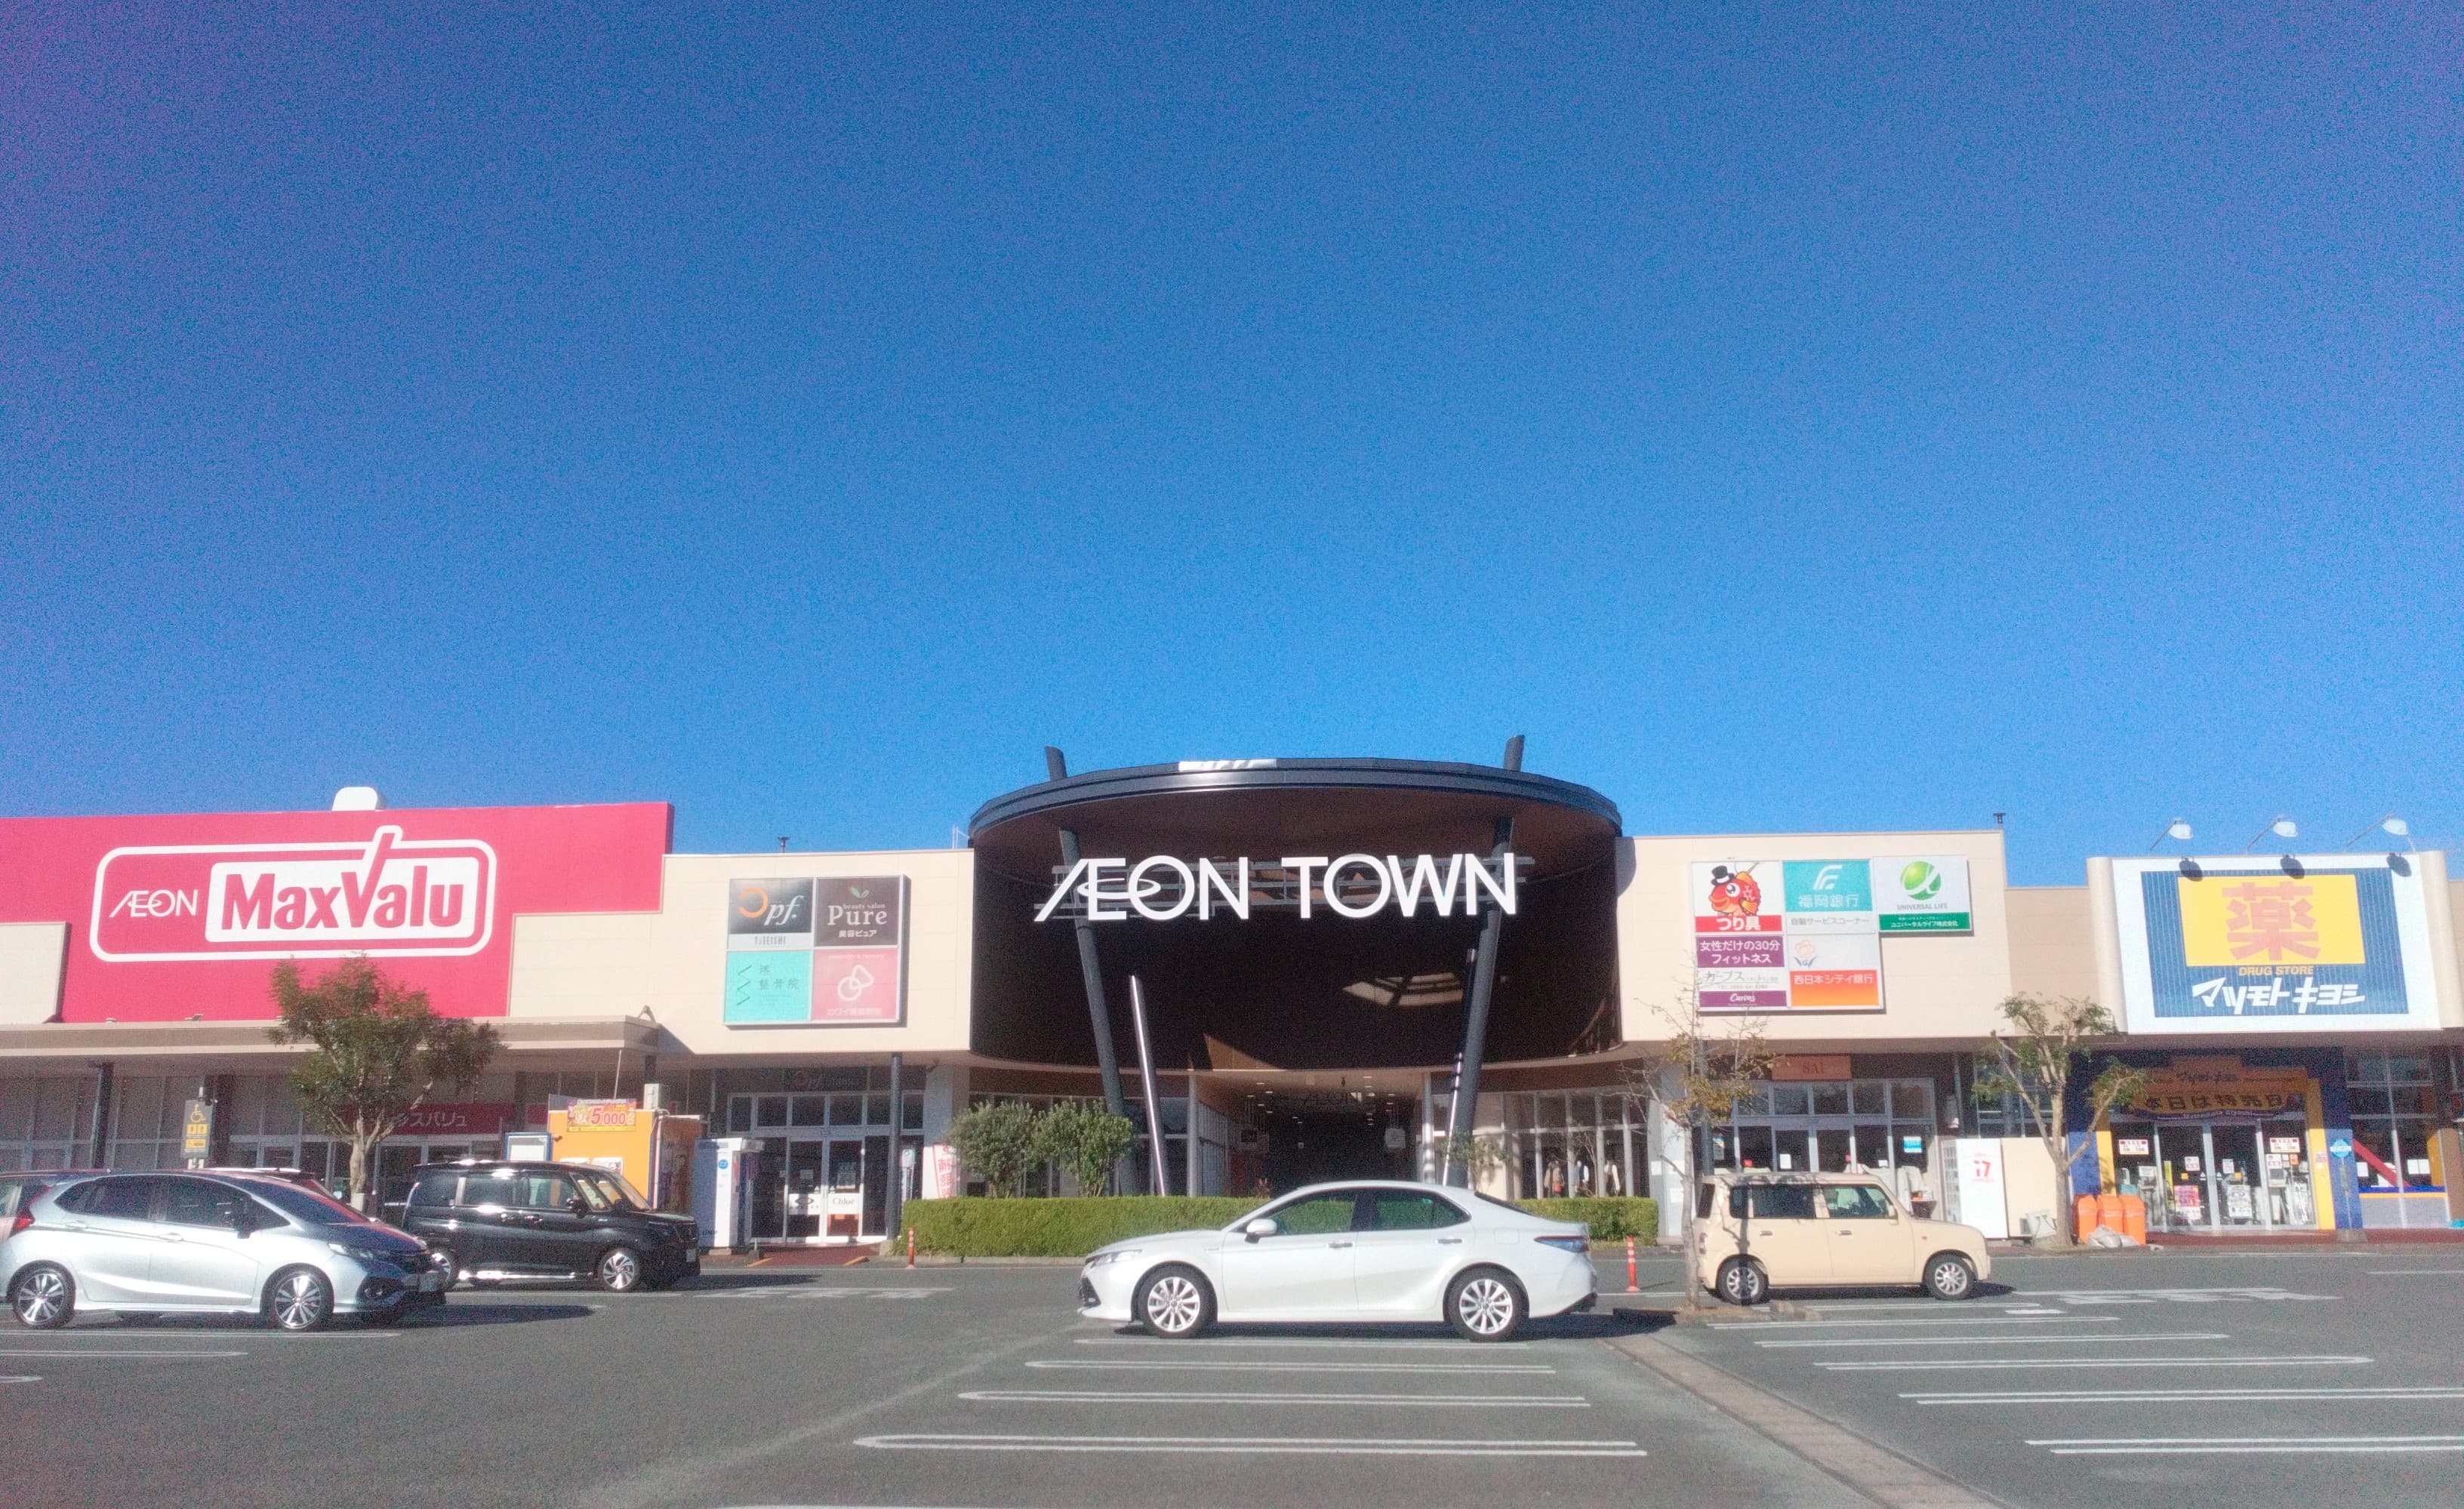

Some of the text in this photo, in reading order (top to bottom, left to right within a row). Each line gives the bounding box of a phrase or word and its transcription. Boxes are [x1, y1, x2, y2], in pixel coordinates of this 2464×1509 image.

[221, 833, 464, 930] MaxValu
[1281, 852, 1517, 919] TOWN
[1798, 893, 1859, 908] 福岡銀行
[827, 904, 887, 926] Pure
[1791, 916, 1871, 925] 自動サービスコーナー
[2222, 881, 2321, 961] 薬
[1716, 916, 1761, 931] つり具
[1699, 939, 1781, 952] 女性だけの30分
[1711, 953, 1773, 965] フィットネス
[2238, 965, 2314, 976] DRUG STORE
[1793, 974, 1874, 985] 西日本シティ銀行
[2191, 977, 2366, 1015] マツモトキヨシ
[2145, 1094, 2283, 1110] 本日は特売日
